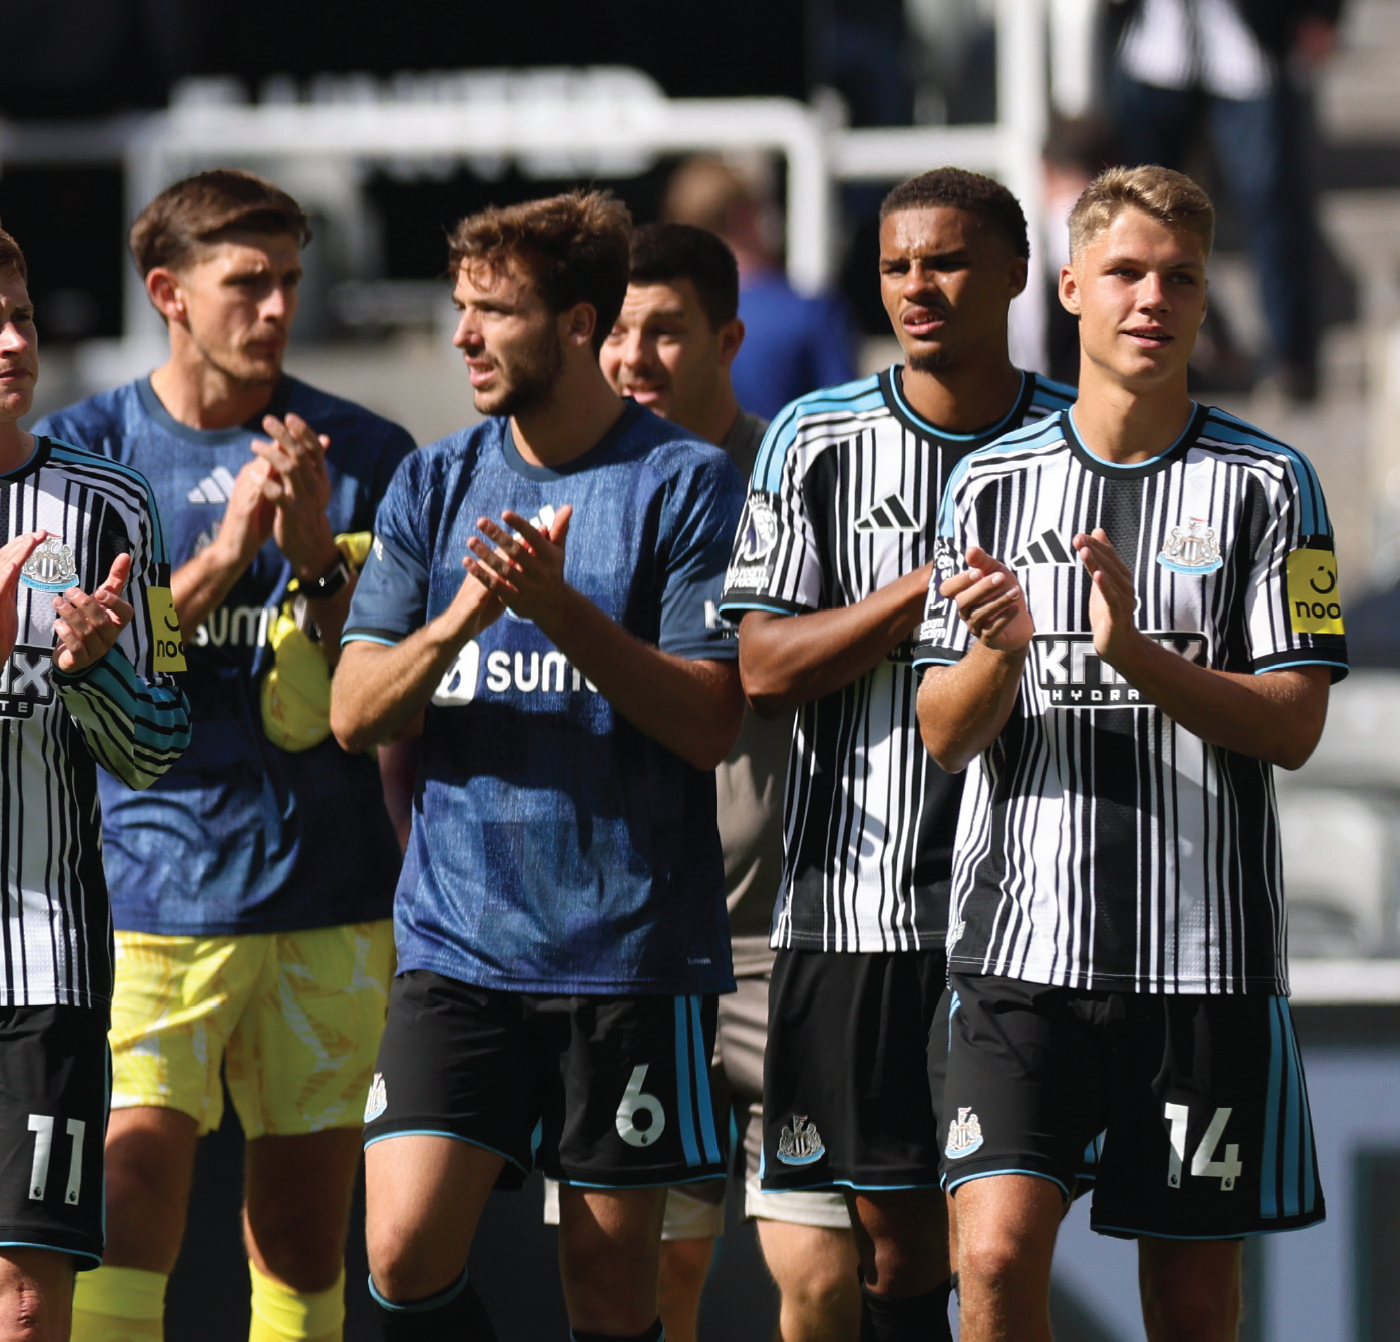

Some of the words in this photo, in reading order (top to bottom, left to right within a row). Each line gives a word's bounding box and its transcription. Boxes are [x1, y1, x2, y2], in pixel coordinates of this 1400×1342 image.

[486, 650, 598, 693] sum
[1052, 689, 1140, 701] HYDRA
[615, 1064, 665, 1147] 6
[1164, 1102, 1243, 1192] 14
[27, 1114, 86, 1205] 11
